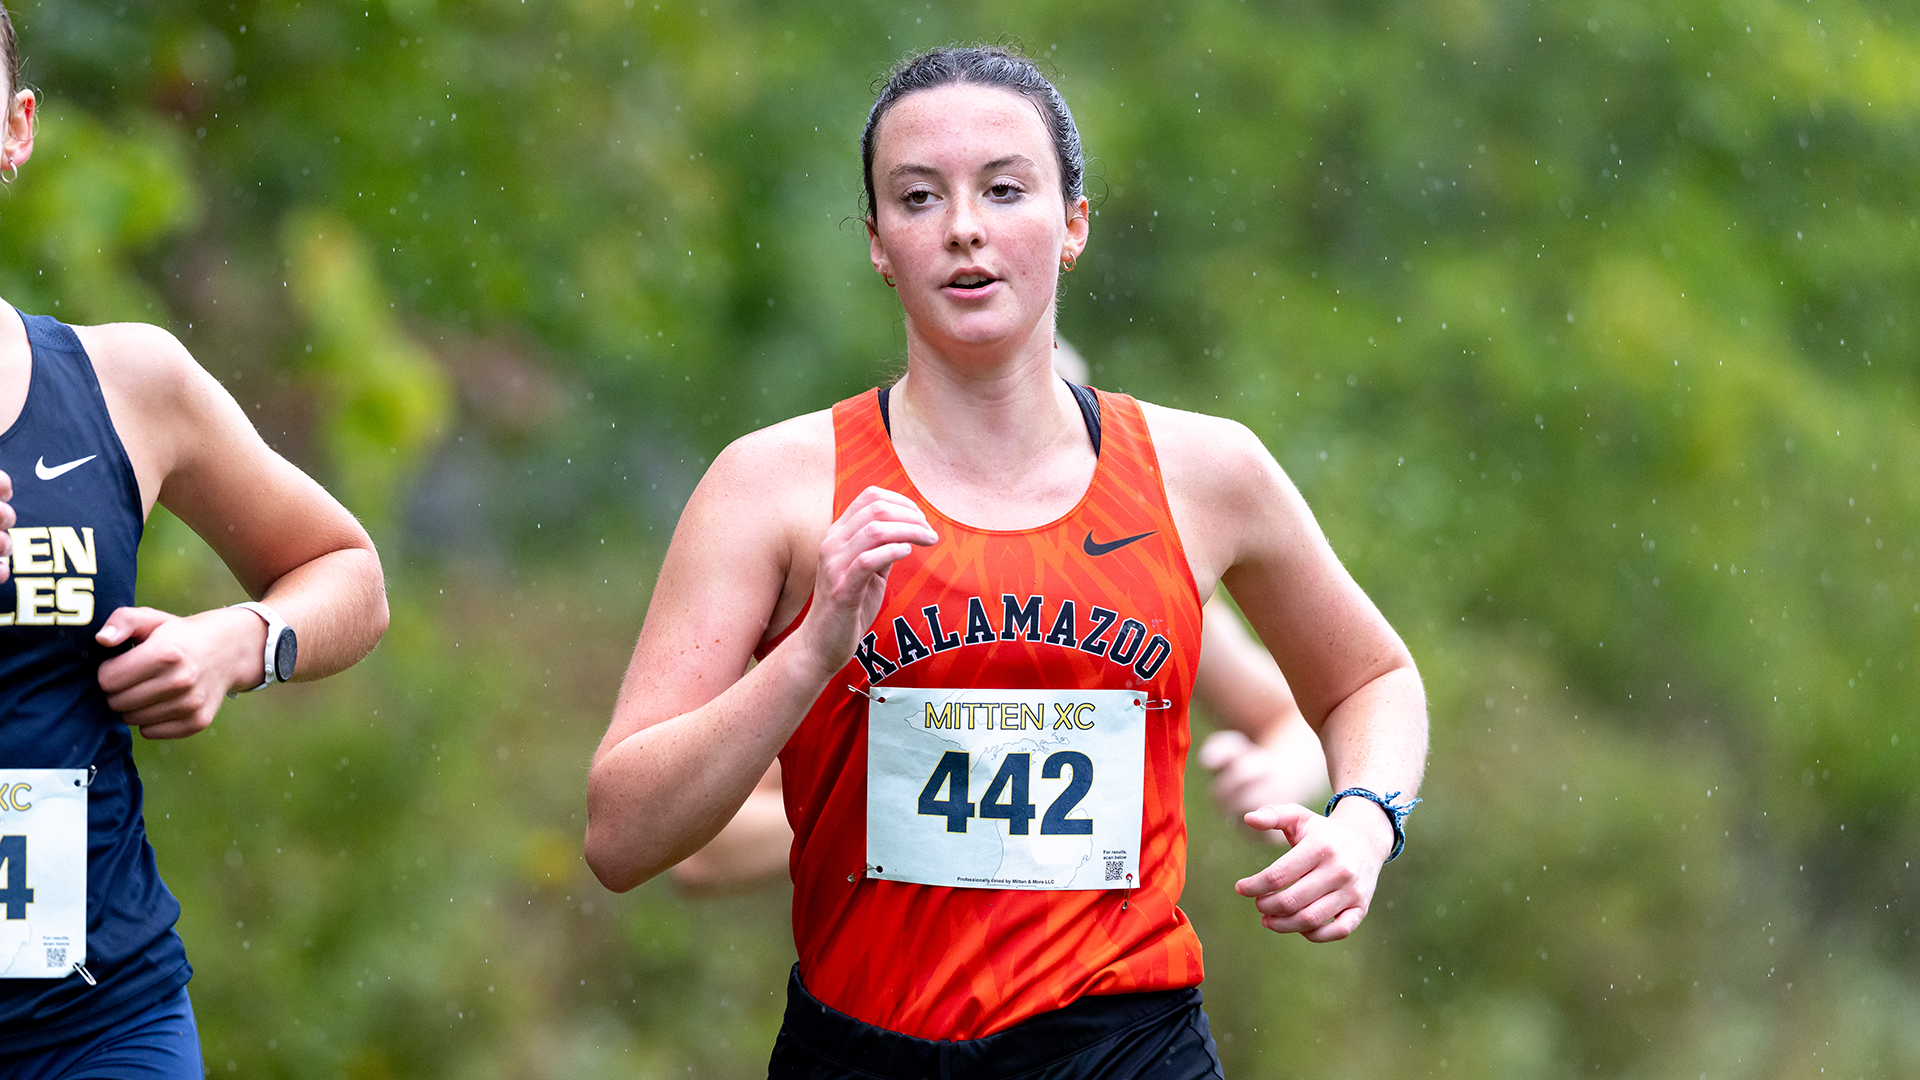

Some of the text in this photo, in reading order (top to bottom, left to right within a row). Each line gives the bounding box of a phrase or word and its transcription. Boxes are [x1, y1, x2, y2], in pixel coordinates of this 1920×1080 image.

[0, 526, 97, 575] EN
[854, 593, 1172, 685] KALAMAZOO
[924, 702, 1096, 731] MITTEN XC
[917, 750, 1094, 836] 442
[957, 876, 990, 884] Professionally
